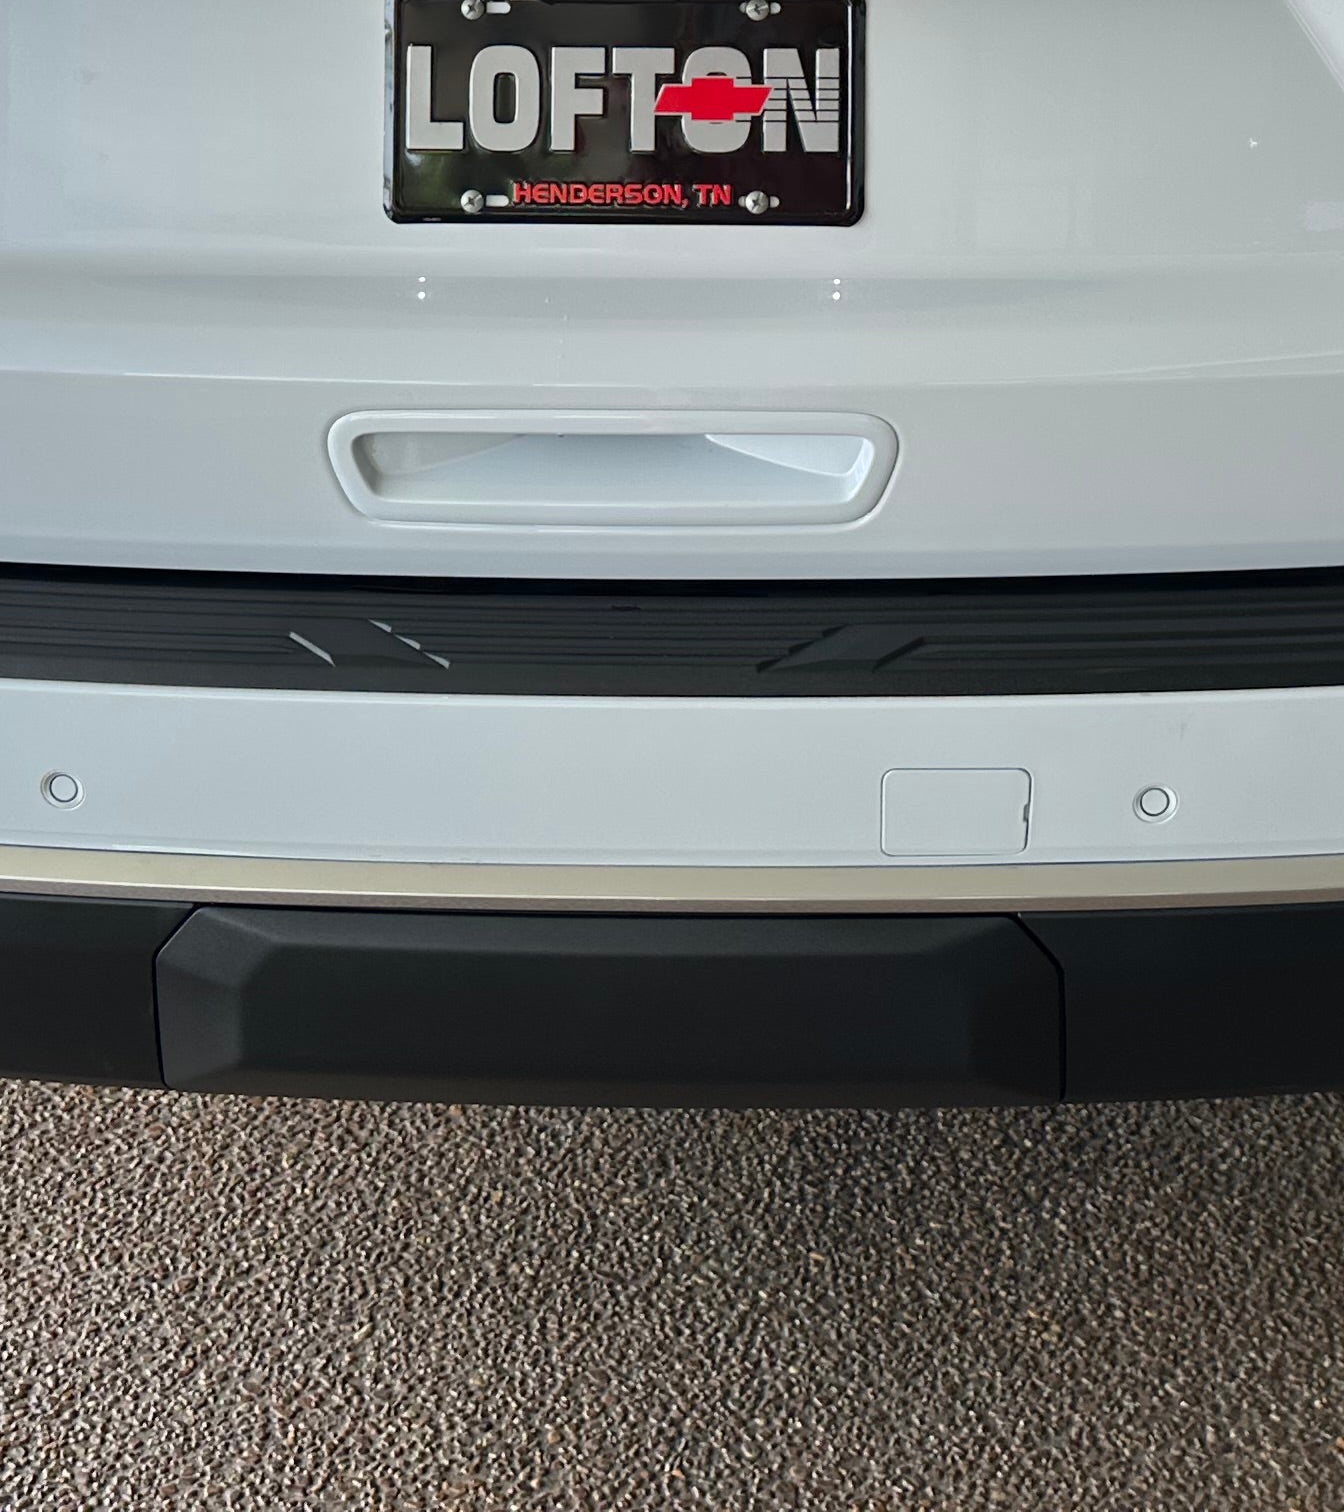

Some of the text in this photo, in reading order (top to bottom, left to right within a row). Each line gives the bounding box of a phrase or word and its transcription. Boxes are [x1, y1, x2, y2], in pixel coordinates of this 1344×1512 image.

[405, 44, 841, 154] LOFTON
[513, 182, 732, 208] HENDERSON, TN
